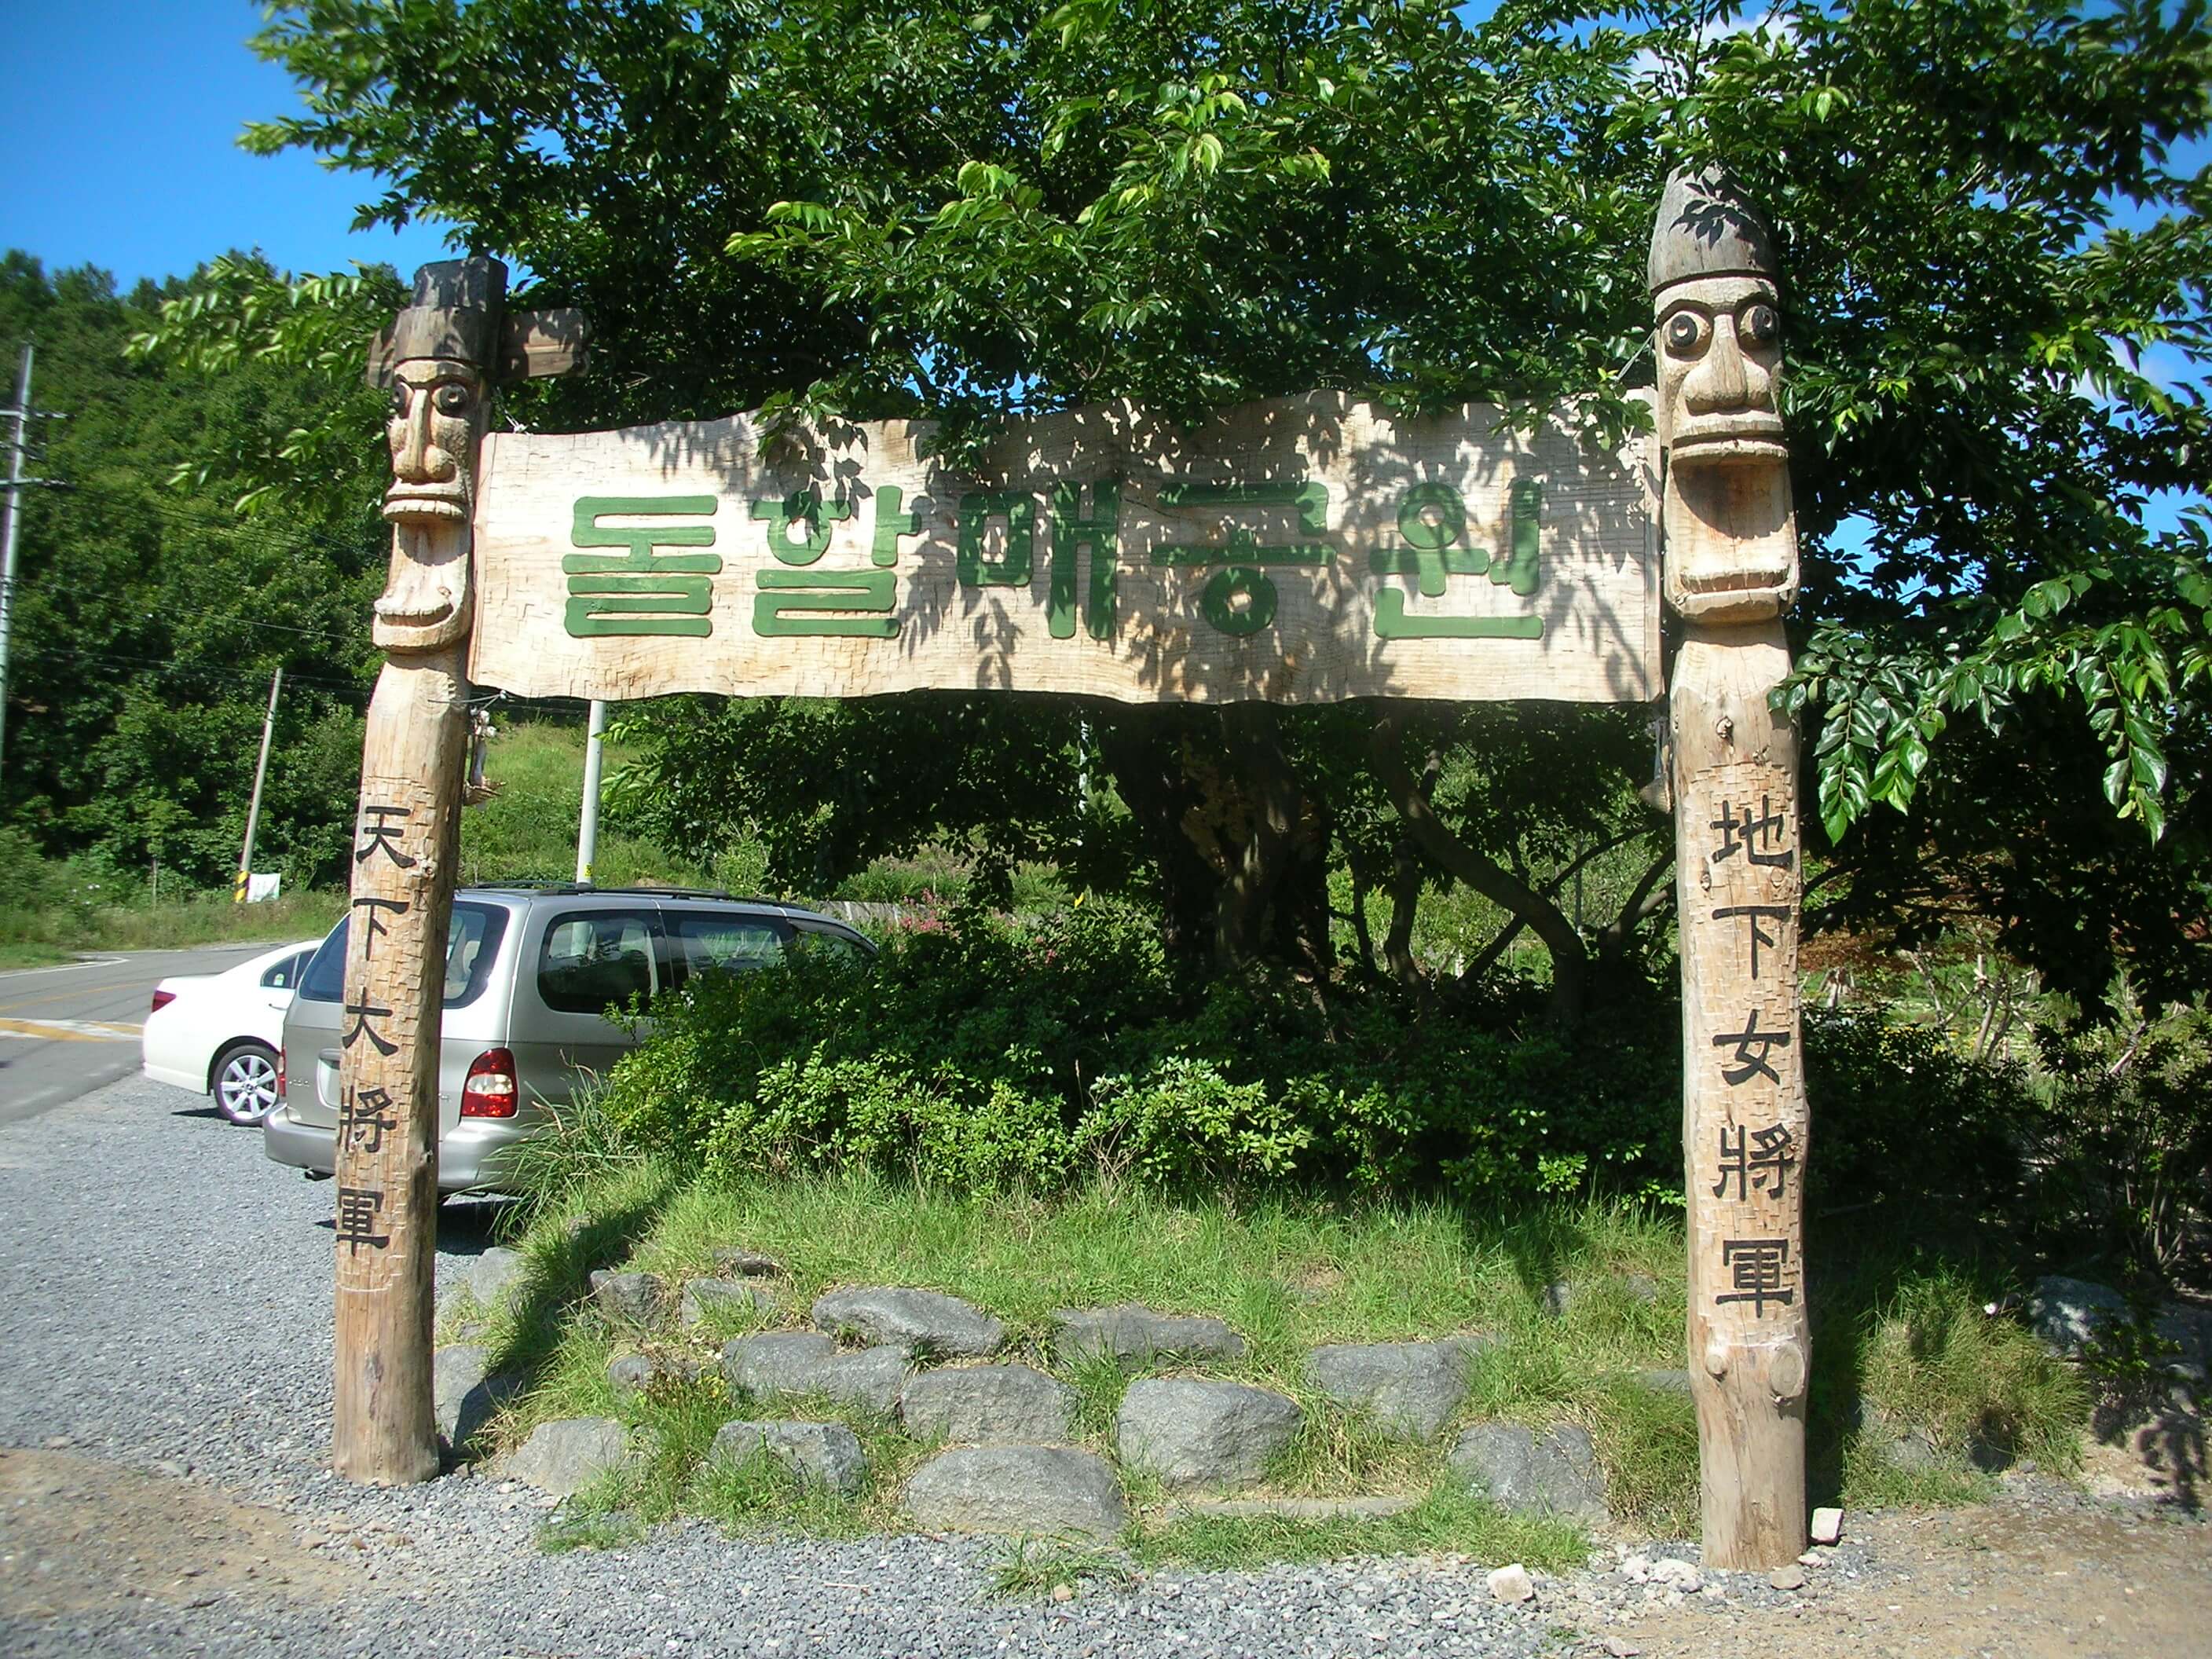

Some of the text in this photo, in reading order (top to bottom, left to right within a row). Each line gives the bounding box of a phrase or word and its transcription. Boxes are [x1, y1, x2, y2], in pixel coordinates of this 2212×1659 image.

[562, 478, 1544, 641] 돌할매공원
[335, 804, 417, 1257] 天下大將軍
[1709, 794, 1795, 1319] 地下女將軍
